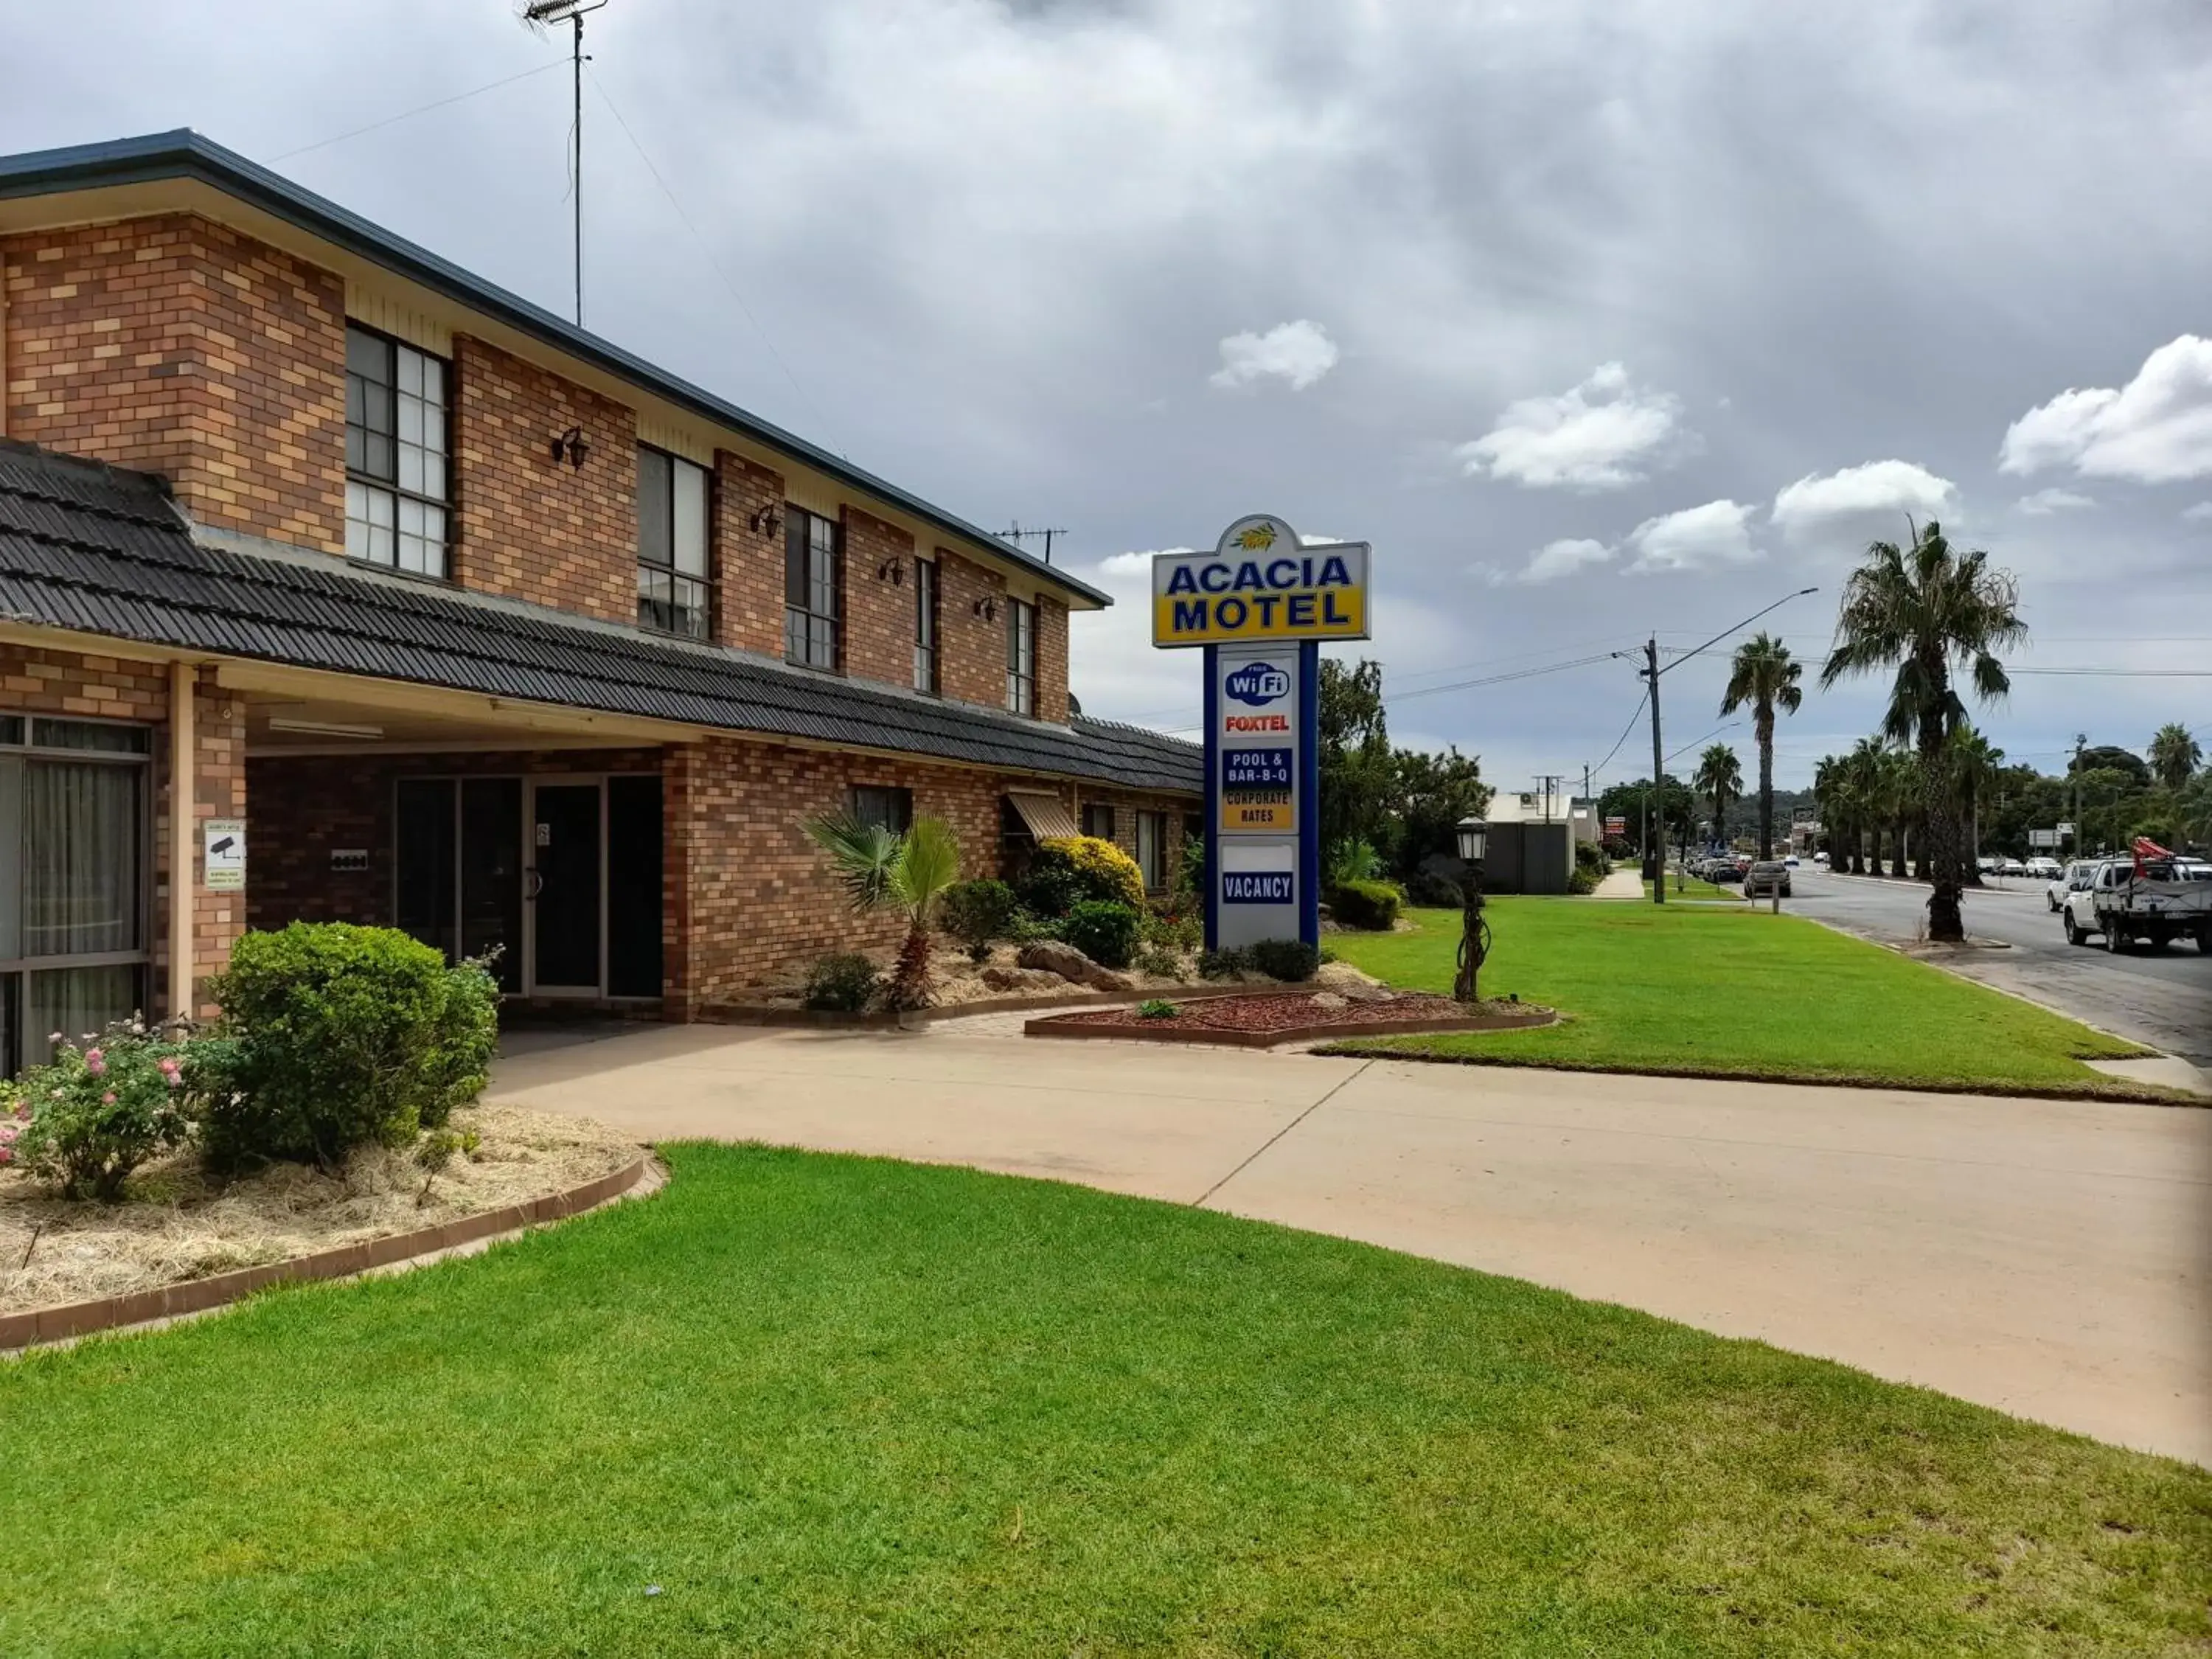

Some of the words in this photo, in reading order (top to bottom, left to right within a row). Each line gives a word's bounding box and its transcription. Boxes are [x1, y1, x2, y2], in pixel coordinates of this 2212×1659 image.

[1165, 556, 1353, 596] ACACIA
[1173, 592, 1352, 632] MOTEL
[1225, 714, 1289, 731] FOXTEL
[1233, 754, 1267, 766] POOL
[1273, 753, 1282, 766] &
[1228, 769, 1287, 782] BAR-B-Q
[1226, 792, 1288, 805] CORPORATE
[1242, 810, 1273, 822] RATES
[1225, 877, 1290, 898] VACANCY
